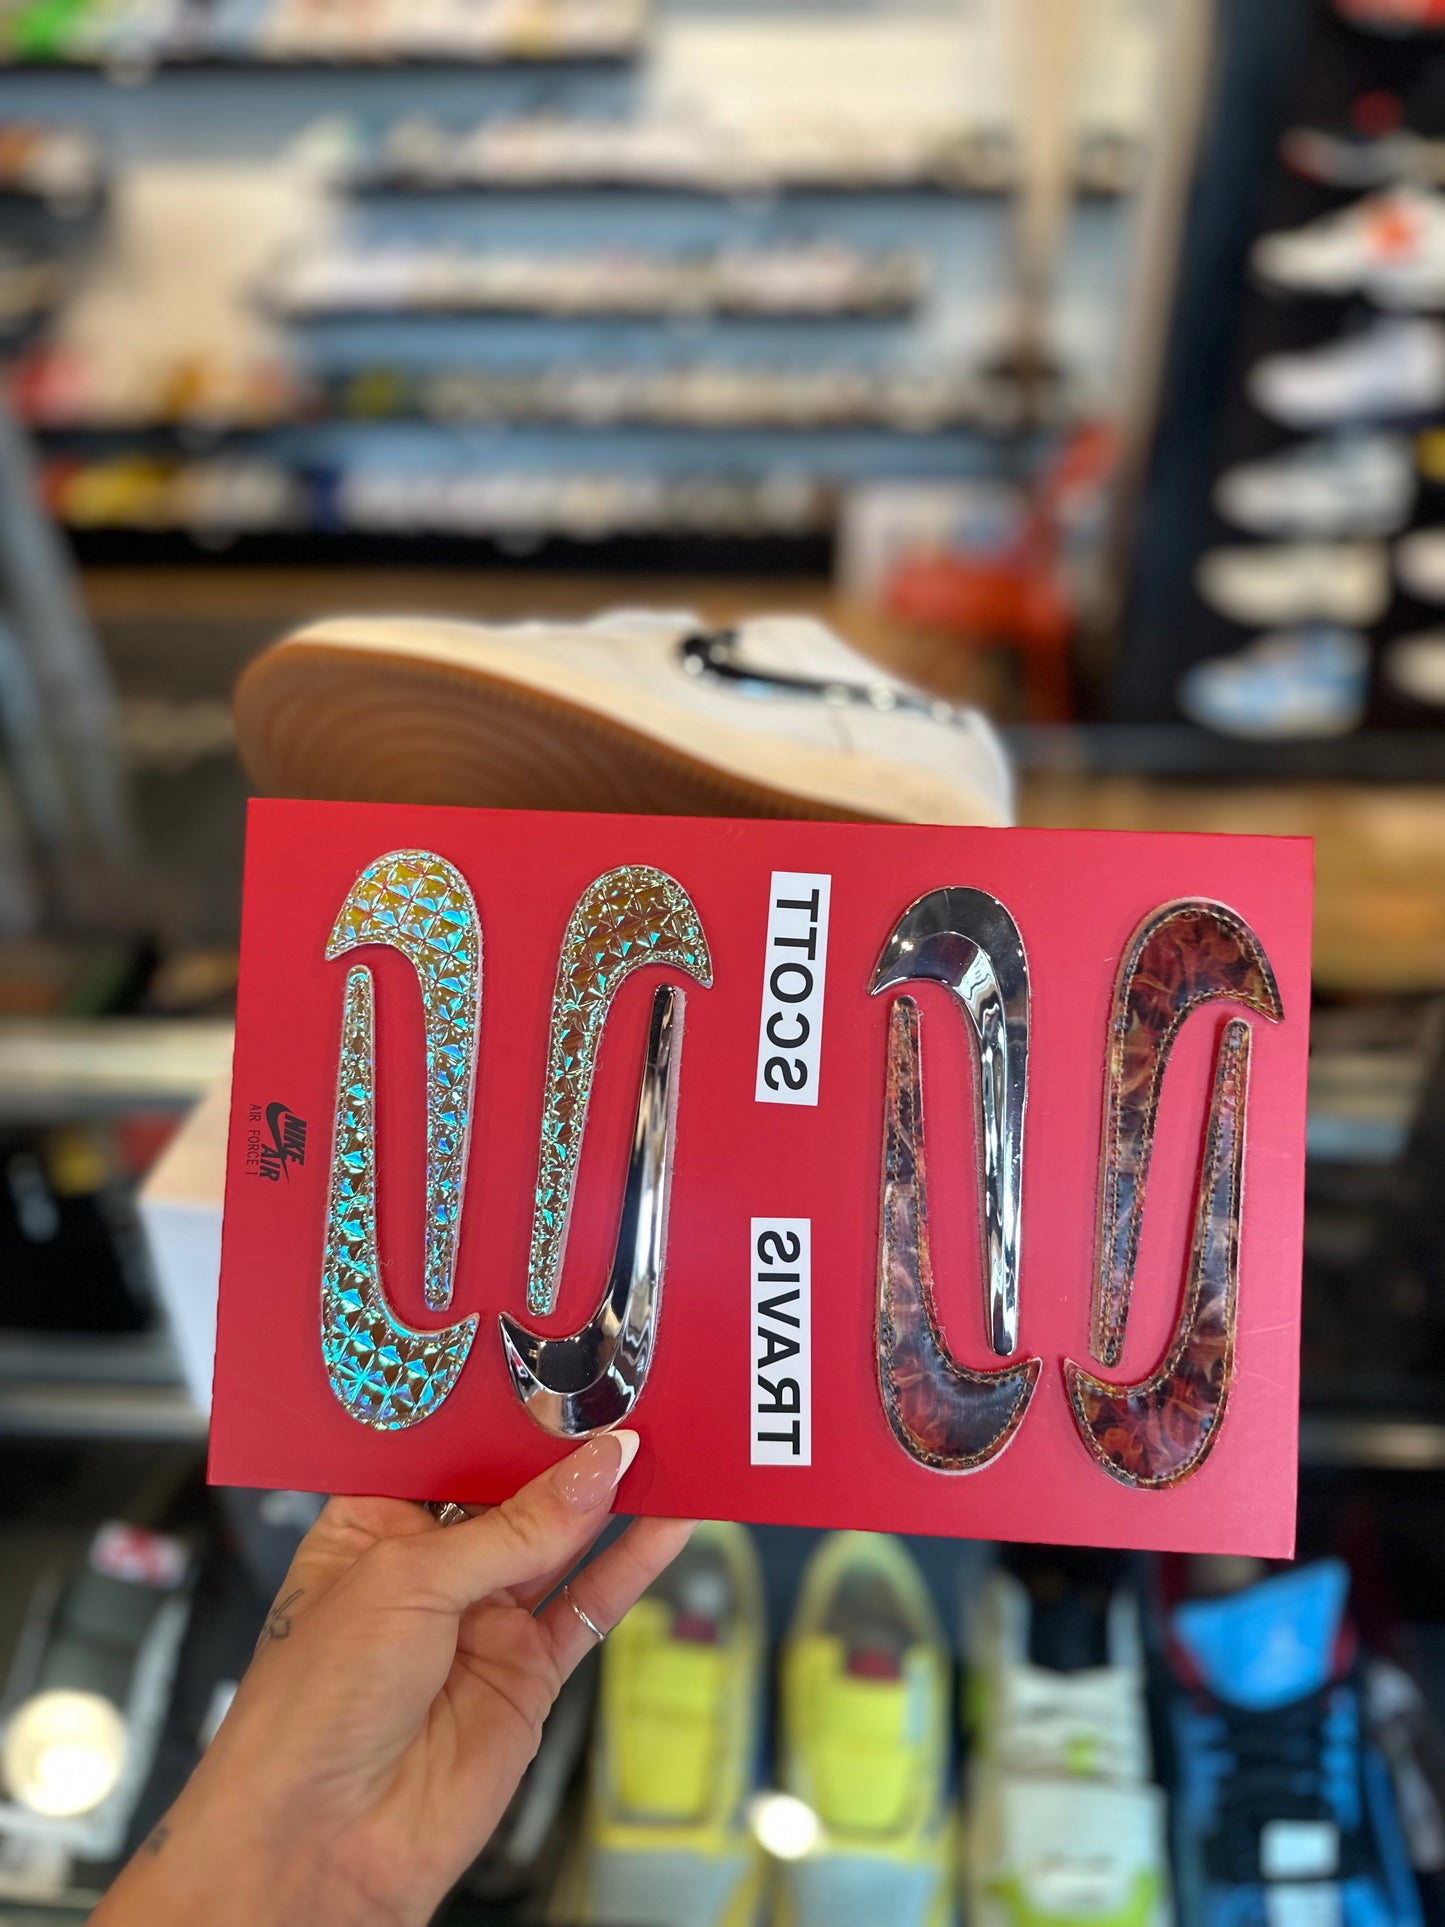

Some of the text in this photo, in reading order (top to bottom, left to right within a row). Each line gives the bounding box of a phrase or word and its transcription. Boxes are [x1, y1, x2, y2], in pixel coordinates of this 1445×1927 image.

[249, 1103, 262, 1122] AIR
[246, 1129, 261, 1166] FORCE
[284, 1113, 307, 1166] NIKE
[260, 1143, 281, 1182] AIR
